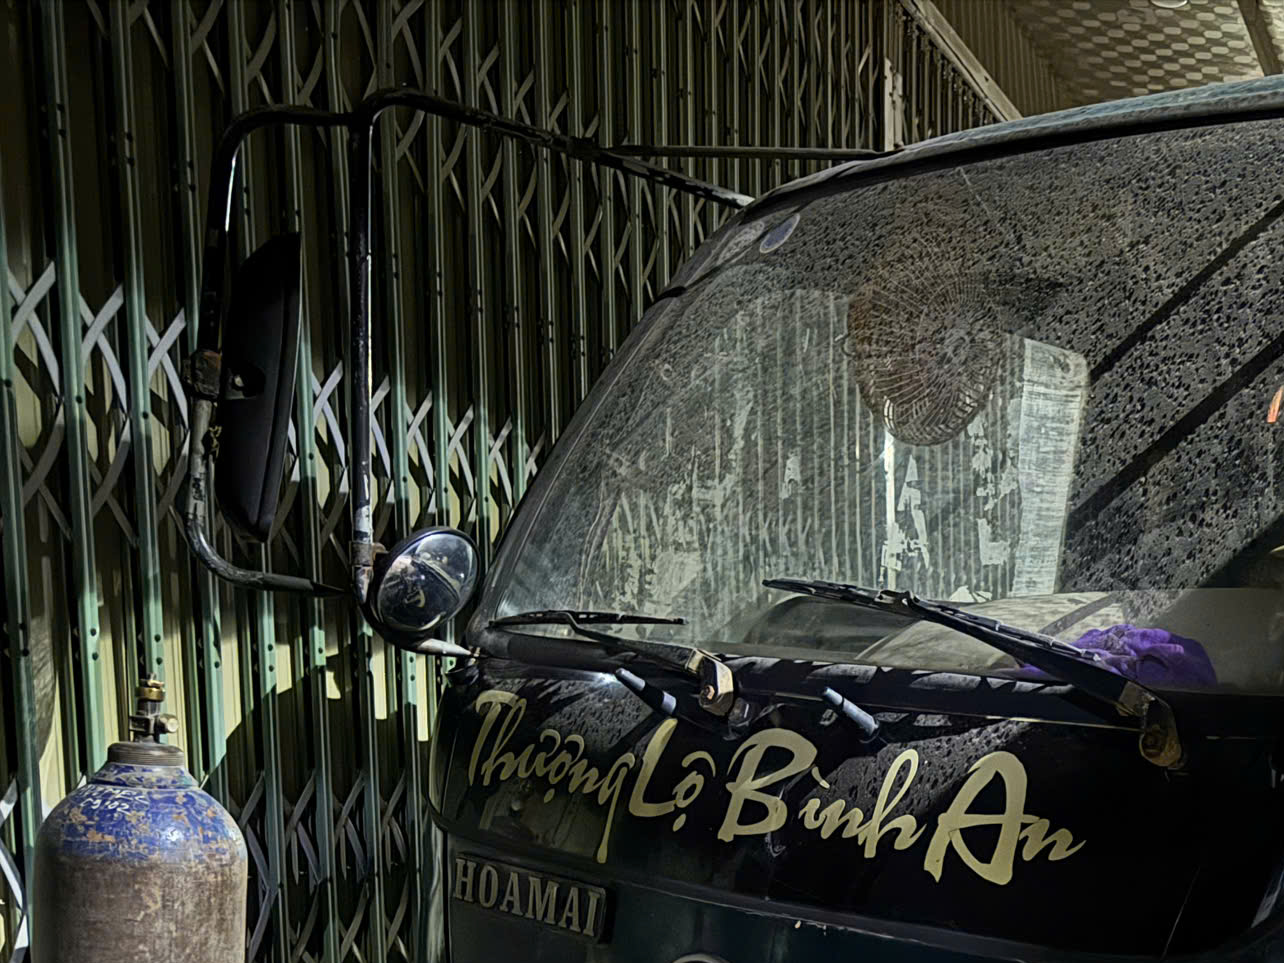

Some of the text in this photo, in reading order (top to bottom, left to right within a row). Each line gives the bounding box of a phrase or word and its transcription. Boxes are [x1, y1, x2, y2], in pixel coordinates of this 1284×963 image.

[628, 718, 716, 831] Lộ
[717, 727, 927, 858] Bình
[922, 750, 1087, 885] An
[452, 857, 607, 938] HOAMAI
